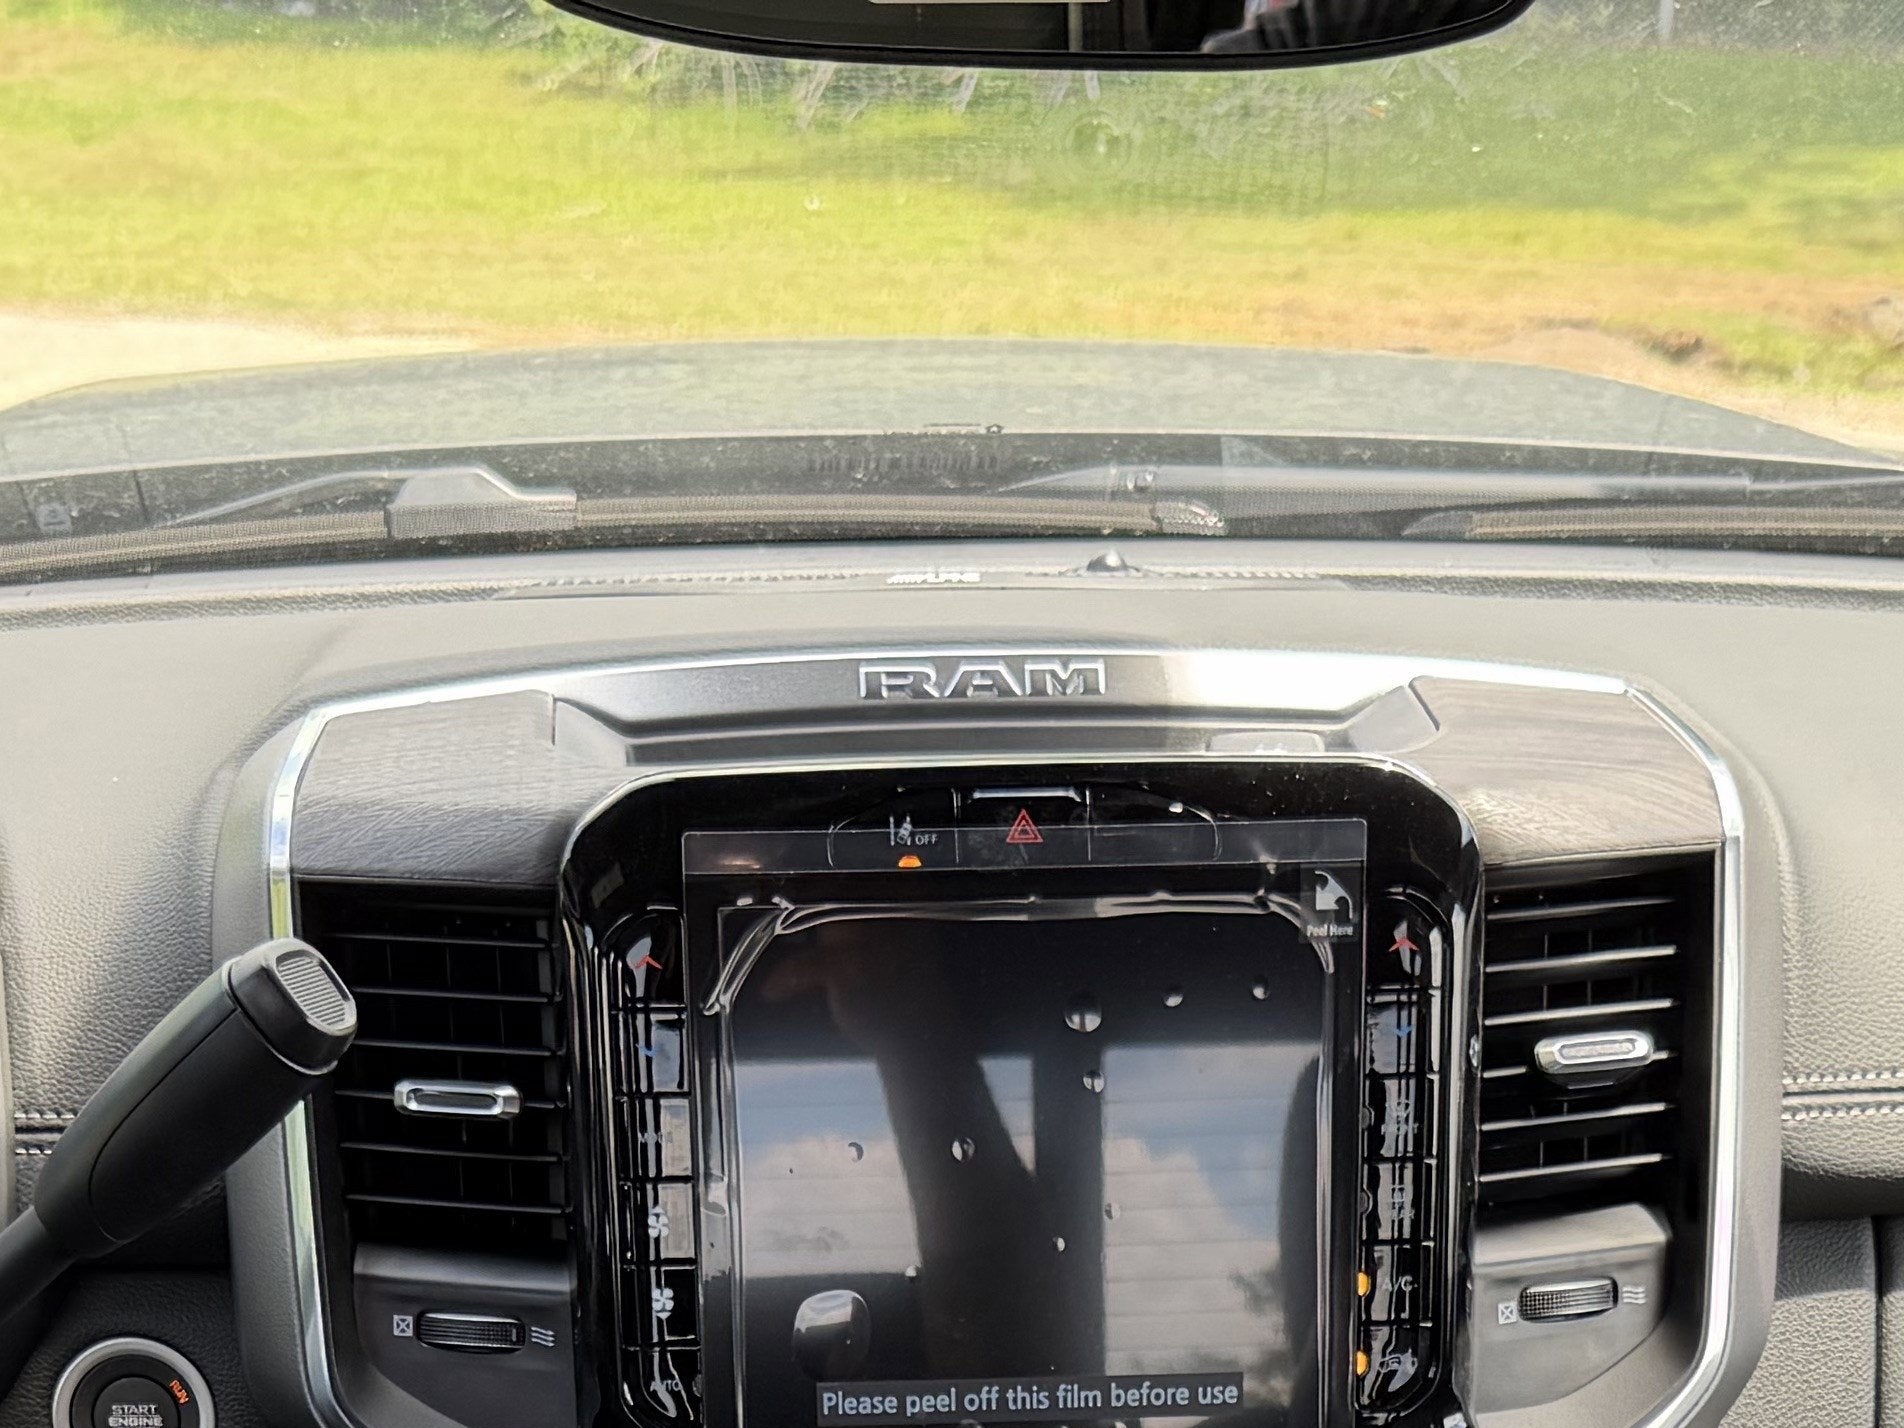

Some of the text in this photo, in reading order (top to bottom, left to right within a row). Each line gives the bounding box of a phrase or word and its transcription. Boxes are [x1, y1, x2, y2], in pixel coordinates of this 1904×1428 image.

[858, 659, 1106, 700] RAM
[915, 834, 938, 846] OFF
[822, 1381, 1239, 1417] Please peel off this film before use
[111, 1404, 158, 1415] START
[108, 1416, 164, 1427] ENGINE
